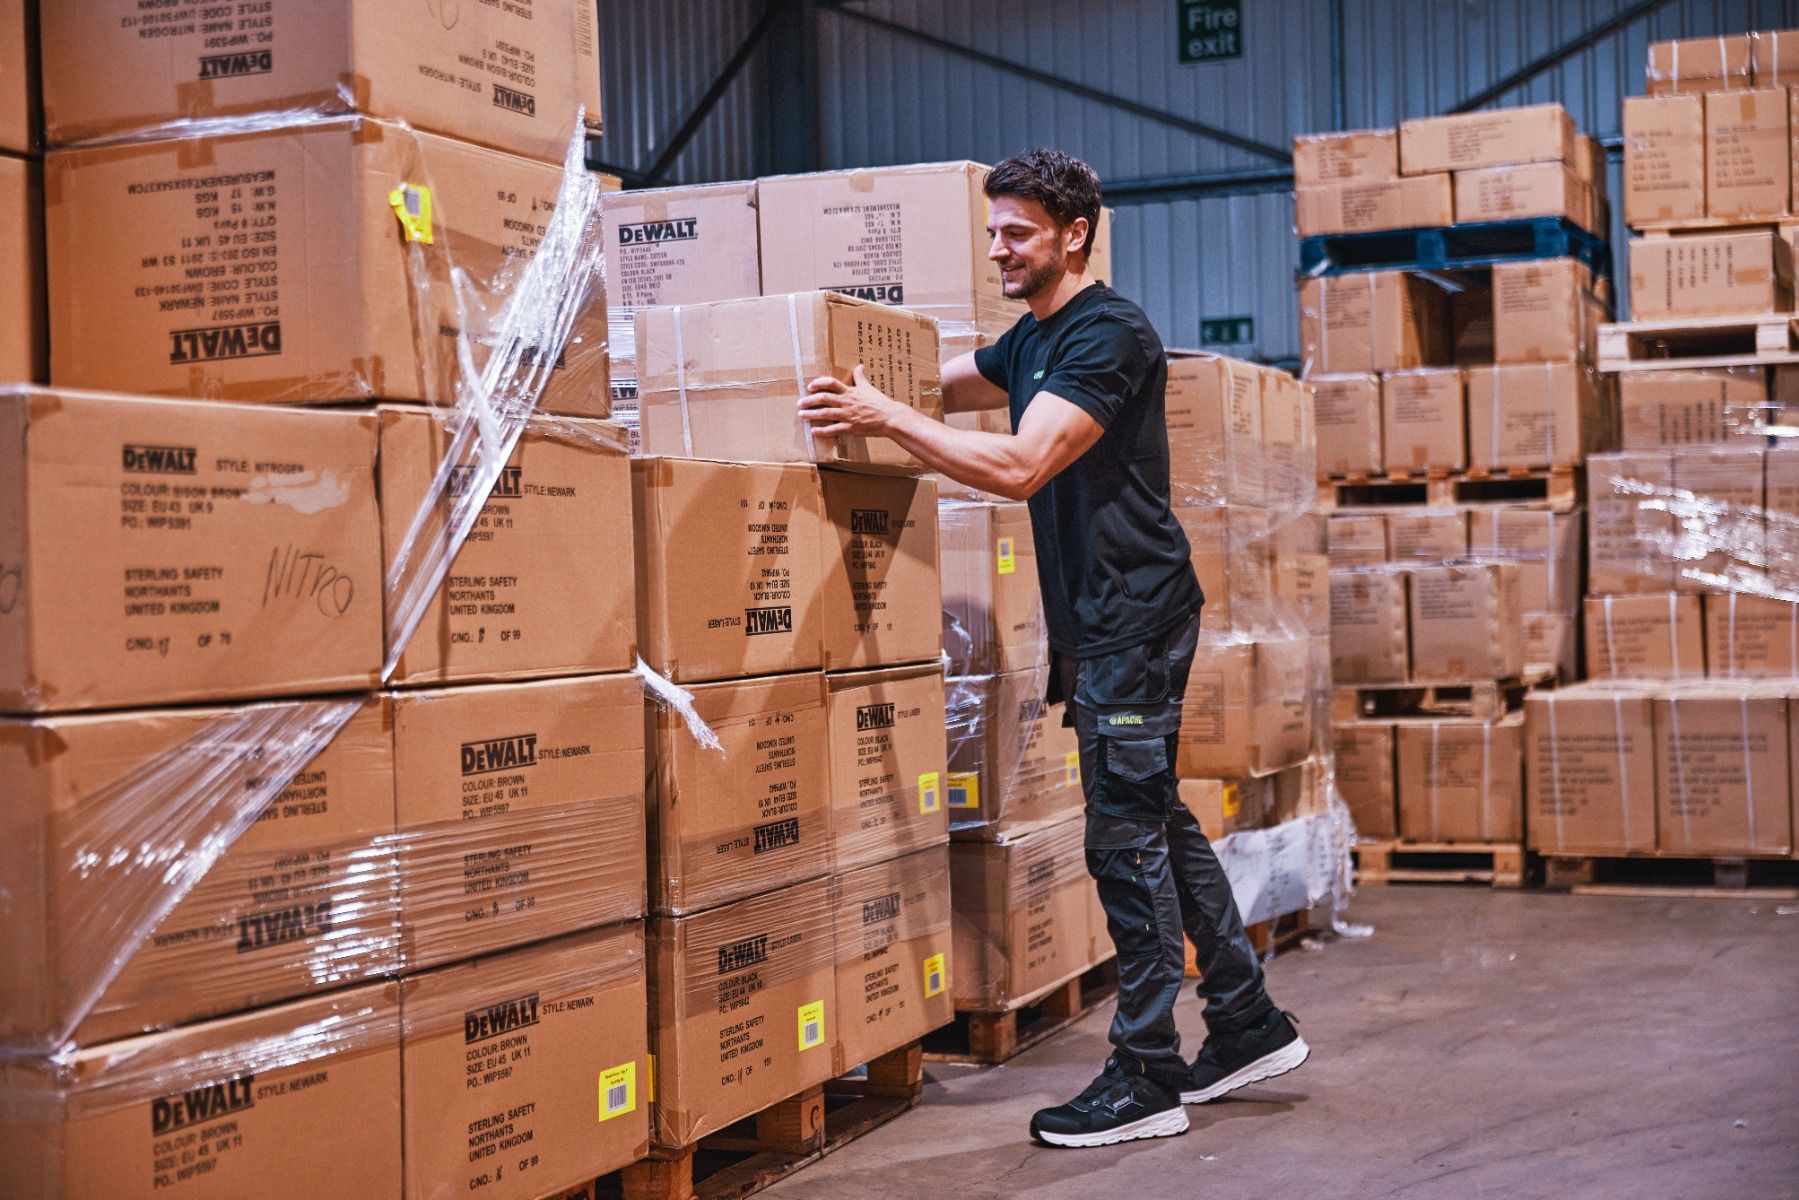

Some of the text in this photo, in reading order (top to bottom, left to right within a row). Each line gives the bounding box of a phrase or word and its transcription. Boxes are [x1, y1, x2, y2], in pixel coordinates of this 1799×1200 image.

[238, 1, 272, 14] STYLE
[1188, 7, 1237, 32] Fire
[139, 16, 272, 38] STYLE NITROGEN
[1188, 32, 1236, 58] exit
[418, 65, 456, 84] NITROGEN
[195, 192, 218, 203] KGS
[196, 206, 219, 218] KGS
[619, 219, 698, 245] DEWALT
[181, 238, 192, 248] 11
[195, 236, 211, 247] UK
[218, 236, 230, 246] 45
[232, 234, 248, 244] EU
[242, 248, 260, 260] ISO
[262, 246, 277, 256] EN
[185, 266, 226, 278] BROWN
[244, 276, 278, 288] STYLE
[245, 291, 278, 304] STYLE
[158, 297, 205, 312] NEWARK
[255, 462, 304, 474] NITROGEN
[173, 486, 206, 498] BISON
[548, 487, 576, 498] NEWARK
[152, 502, 167, 513] EU
[188, 502, 204, 513] UK
[493, 519, 513, 528] UK 11
[124, 568, 223, 582] STERLING SAFETY
[262, 544, 354, 619] NITRO
[448, 577, 518, 588] STERLING SAFETY
[124, 586, 192, 598] NORTHANTS
[450, 591, 495, 601] NORTHANTS
[125, 601, 220, 616] UNITED KINGDOM
[450, 604, 515, 616] UNITED KINGDOM
[198, 634, 212, 648] OF
[500, 630, 521, 640] OF 99
[1117, 715, 1144, 726] APACHE
[756, 736, 795, 750] UNITED KINGDOM
[461, 735, 537, 775] DEWALT
[562, 745, 590, 758] NEWARK
[768, 747, 796, 760] NORTHANTS
[756, 763, 772, 773] SAFETY
[497, 775, 525, 787] BROWN
[483, 792, 494, 802] EU
[494, 790, 504, 800] 45
[508, 787, 520, 798] UK
[520, 786, 528, 796] 11
[282, 802, 328, 818] STERLING
[762, 808, 777, 818] BLACK
[504, 844, 532, 857] SAFETY
[464, 879, 492, 894] UNITED
[566, 996, 594, 1011] NEWARK
[465, 994, 540, 1044] DEWALT
[720, 1014, 765, 1039] STERLING SAFETY
[500, 1034, 528, 1050] BROWN
[720, 1032, 750, 1050] NORTHANTS
[720, 1039, 763, 1063] UNITED KINGDOM
[466, 1047, 531, 1076] SIZE: EU 45 UK 11
[746, 1066, 753, 1076] OF
[290, 1072, 328, 1092] NEWARK
[468, 1102, 536, 1134] STERLING SAFETY
[201, 1121, 238, 1140] BROWN
[469, 1124, 514, 1148] NORTHANTS
[182, 1150, 194, 1164] EU
[198, 1145, 208, 1156] 45
[216, 1140, 230, 1152] UK
[469, 1130, 534, 1162] UNITED KINGDOM
[518, 1160, 528, 1171] OF
[530, 1156, 539, 1168] 99
